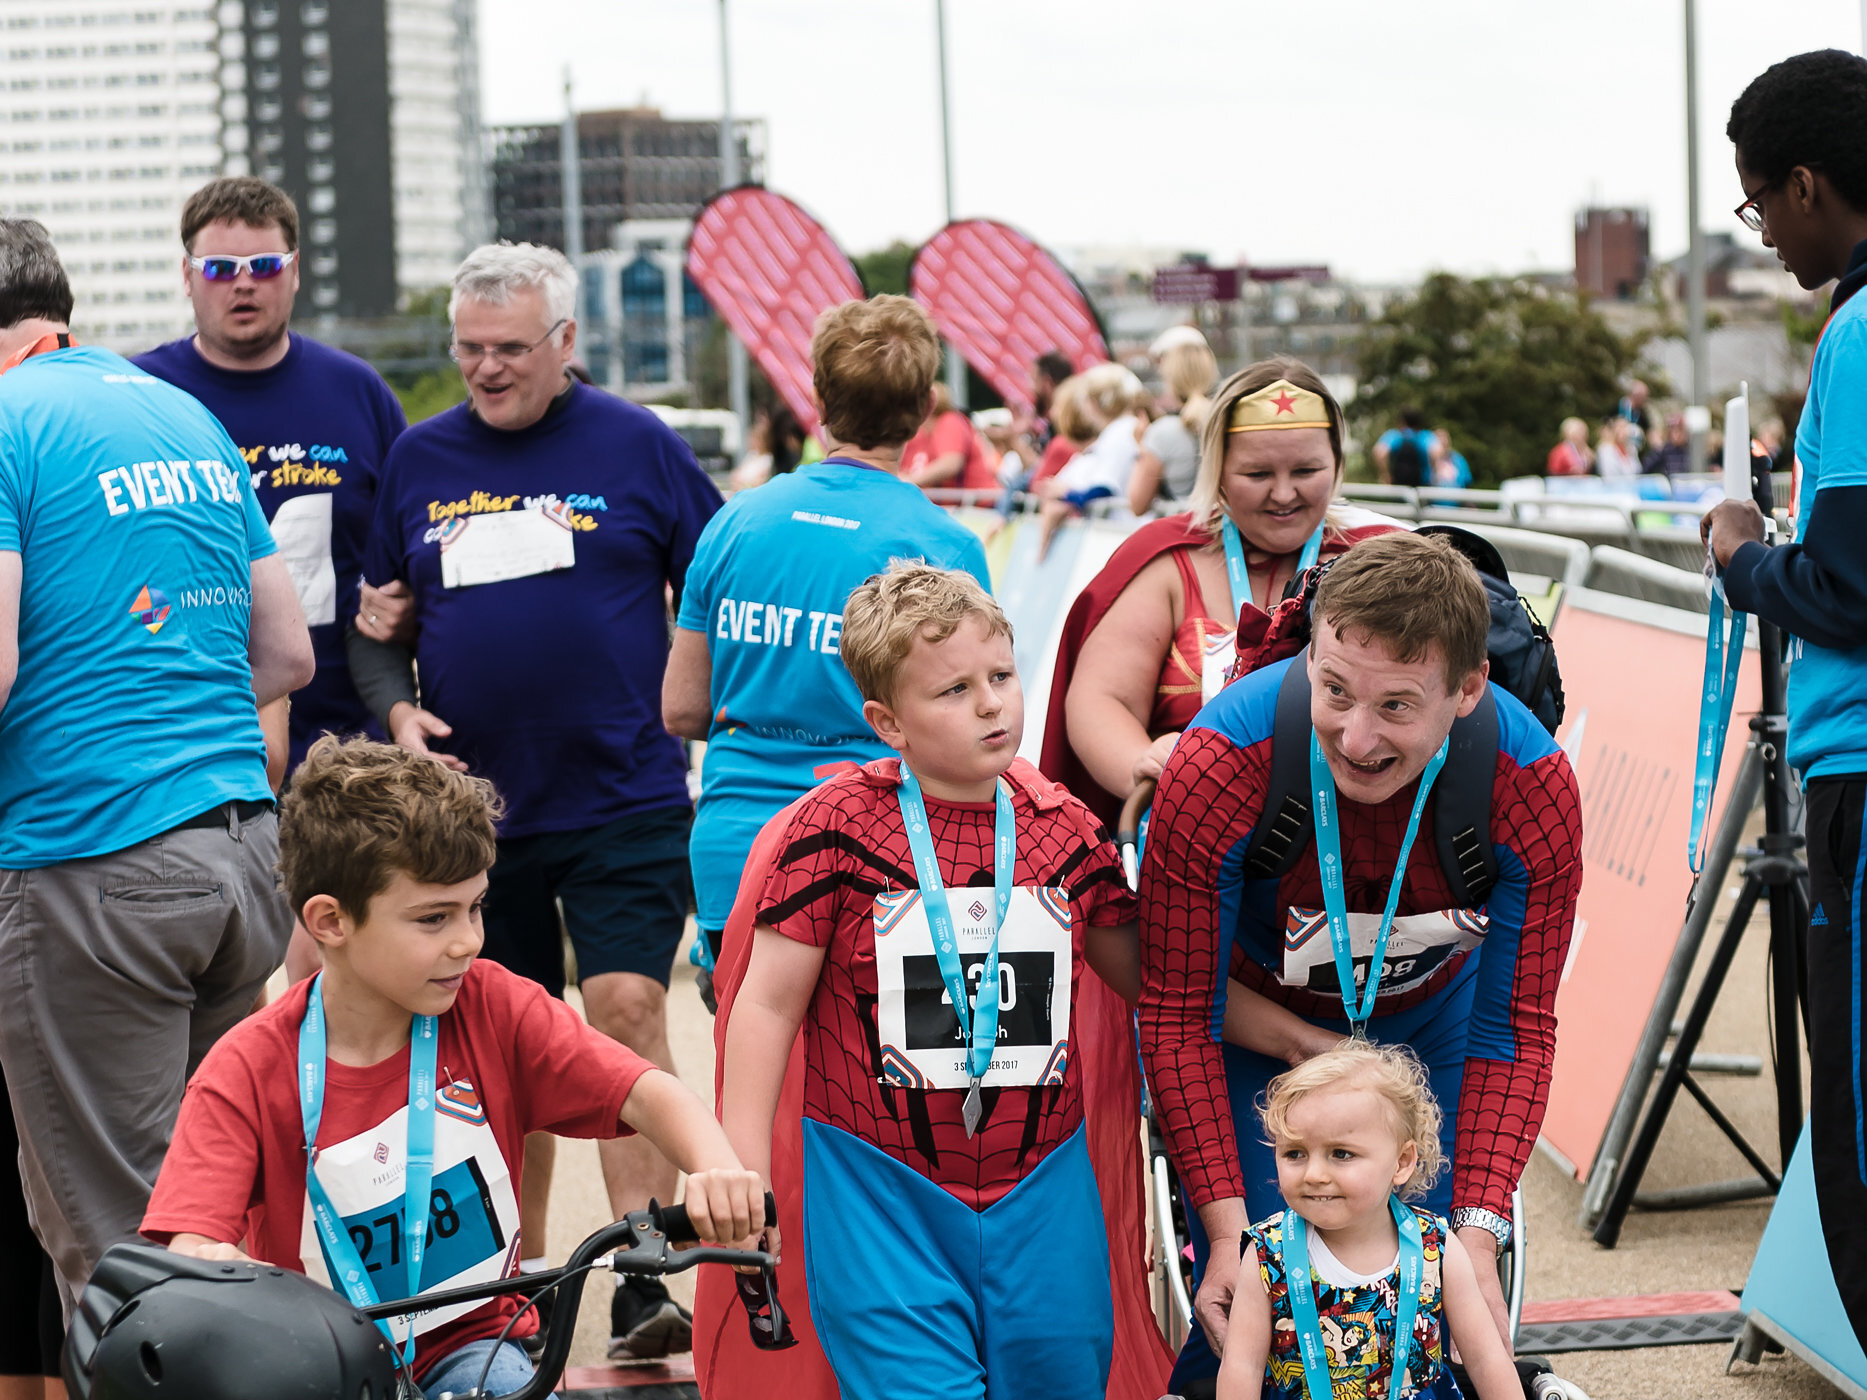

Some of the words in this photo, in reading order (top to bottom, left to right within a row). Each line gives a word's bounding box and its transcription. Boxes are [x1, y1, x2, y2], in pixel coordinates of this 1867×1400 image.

[267, 443, 307, 462] we
[308, 444, 349, 464] can
[98, 460, 197, 517] EVENT
[271, 459, 342, 488] stroke
[427, 490, 521, 524] Together
[523, 493, 561, 511] we
[564, 493, 608, 512] can
[716, 597, 803, 648] EVENT
[808, 611, 843, 655] TE
[1319, 797, 1328, 827] BARCLAYS
[962, 927, 996, 936] PARALLEL
[1334, 923, 1344, 953] BARCLAYS
[954, 1062, 959, 1072] 3
[1001, 1060, 1018, 1070] 2017
[320, 1211, 339, 1245] BARCLAYS
[347, 1188, 460, 1274] 278
[398, 1315, 404, 1325] 3
[1305, 1340, 1317, 1370] BARCLAYS
